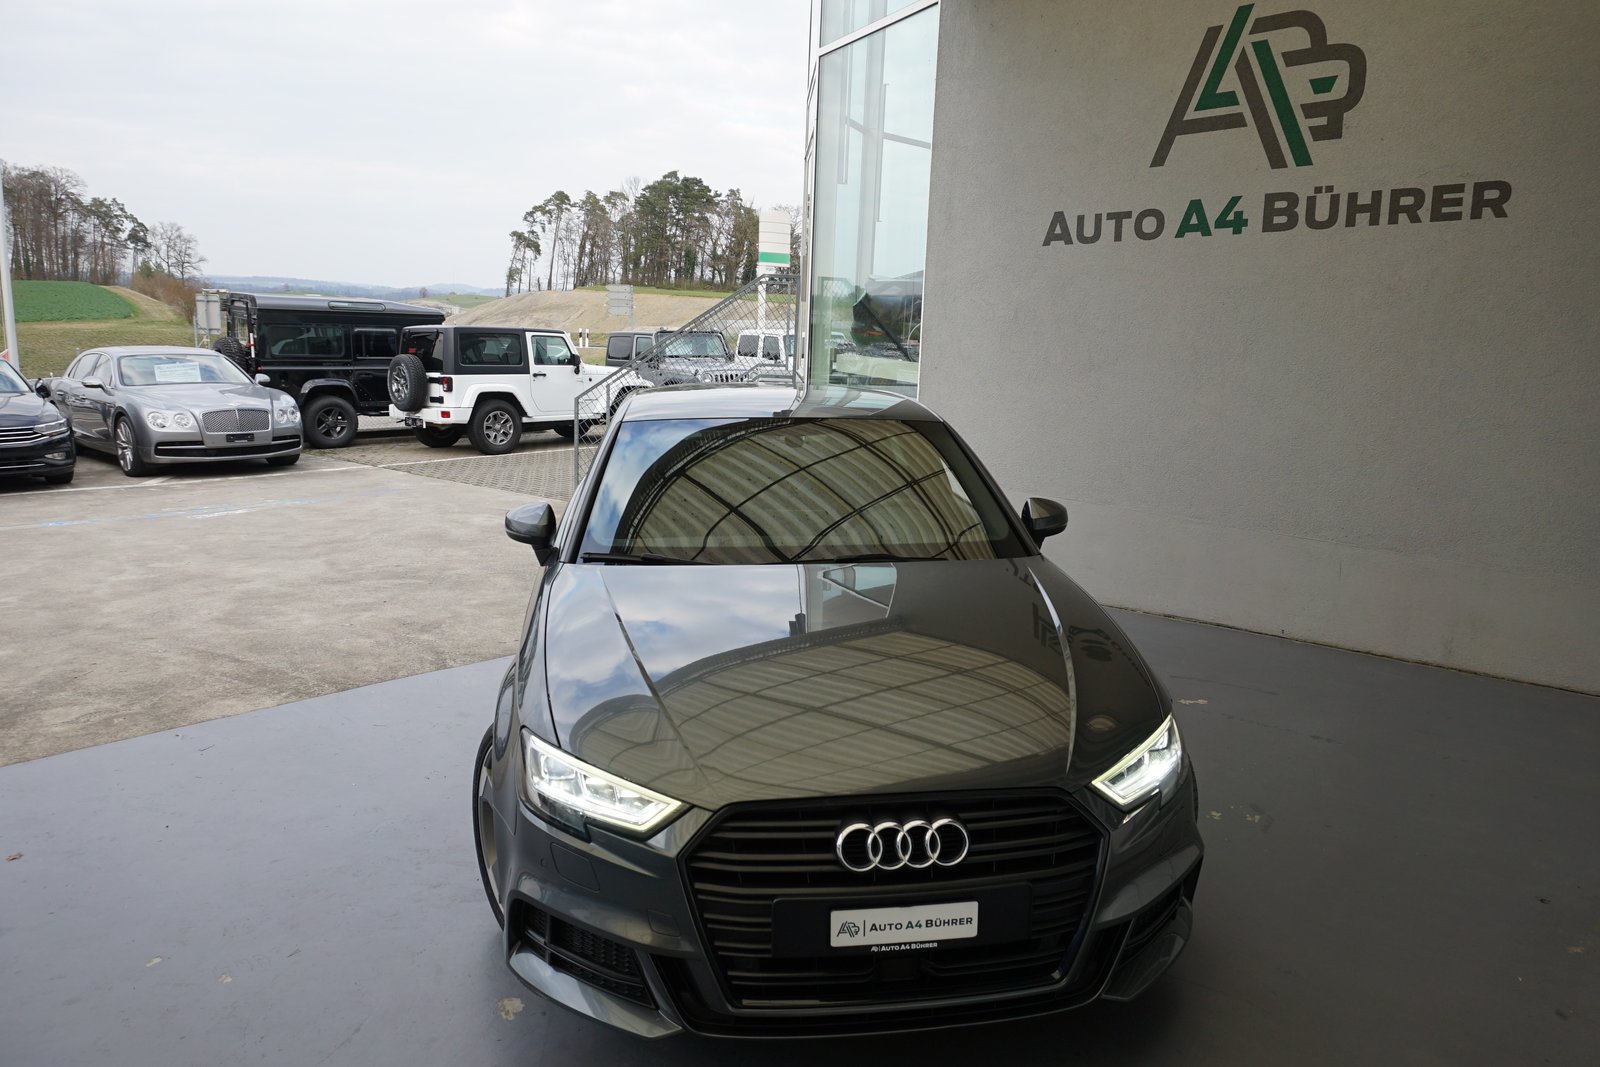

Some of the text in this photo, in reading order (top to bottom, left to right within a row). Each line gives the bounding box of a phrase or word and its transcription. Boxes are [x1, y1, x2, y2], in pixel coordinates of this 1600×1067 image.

[1042, 180, 1513, 247] AUTO A4 BÜHRER
[869, 923, 903, 932] AUTO
[905, 920, 922, 929] A4
[925, 917, 973, 928] BÜHRER
